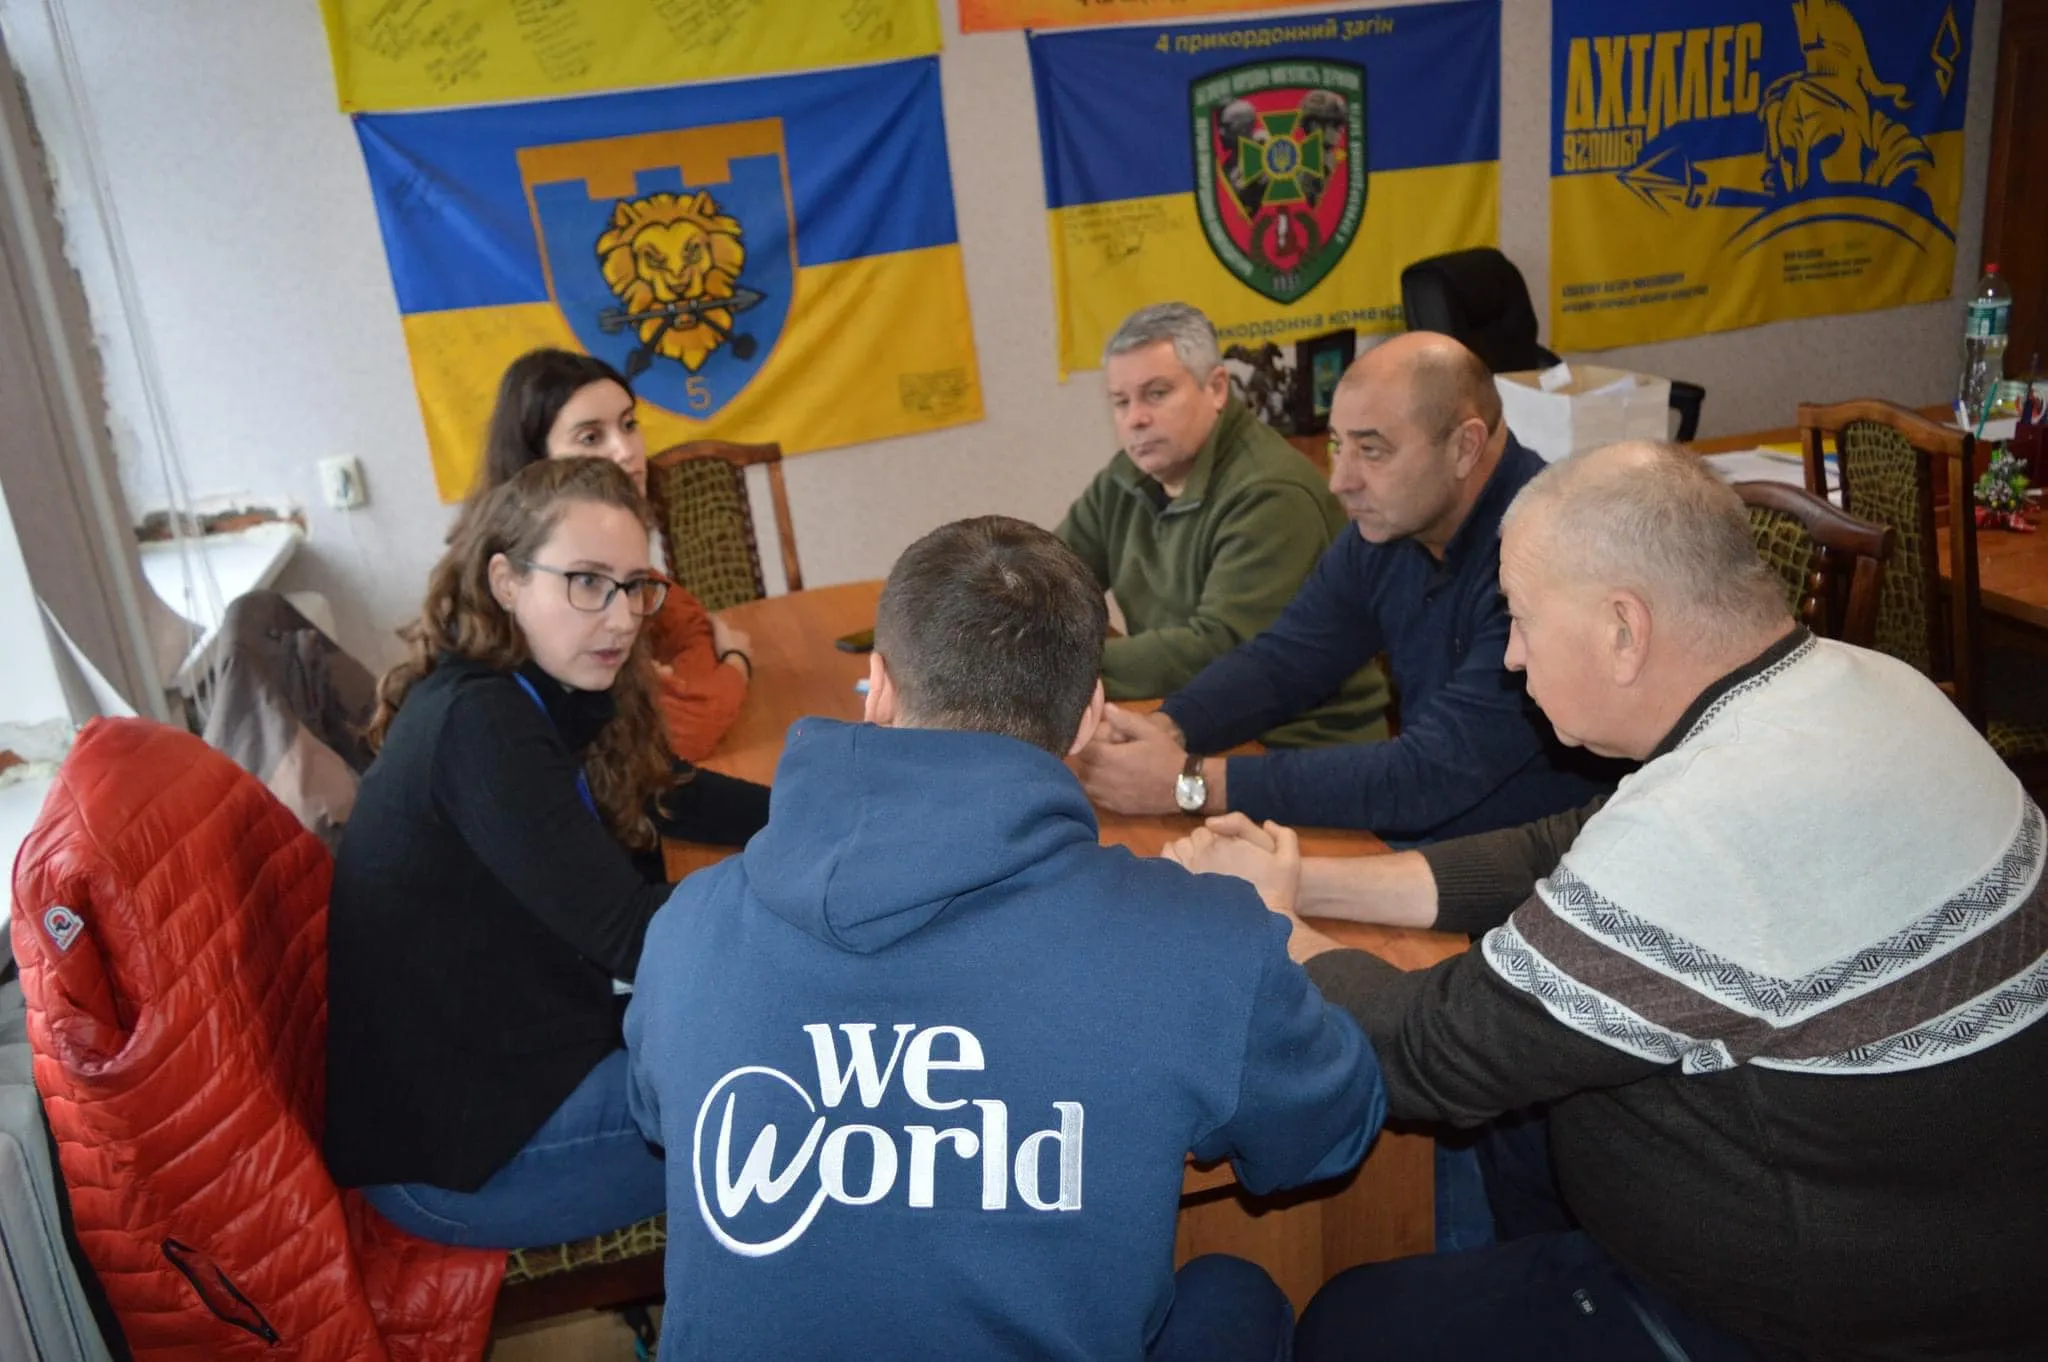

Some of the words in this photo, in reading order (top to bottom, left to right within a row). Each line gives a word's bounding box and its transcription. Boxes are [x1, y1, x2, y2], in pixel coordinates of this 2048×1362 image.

[1155, 32, 1169, 54] 4
[1175, 17, 1337, 54] прикордонний
[1342, 14, 1394, 40] загін
[685, 375, 712, 410] 5
